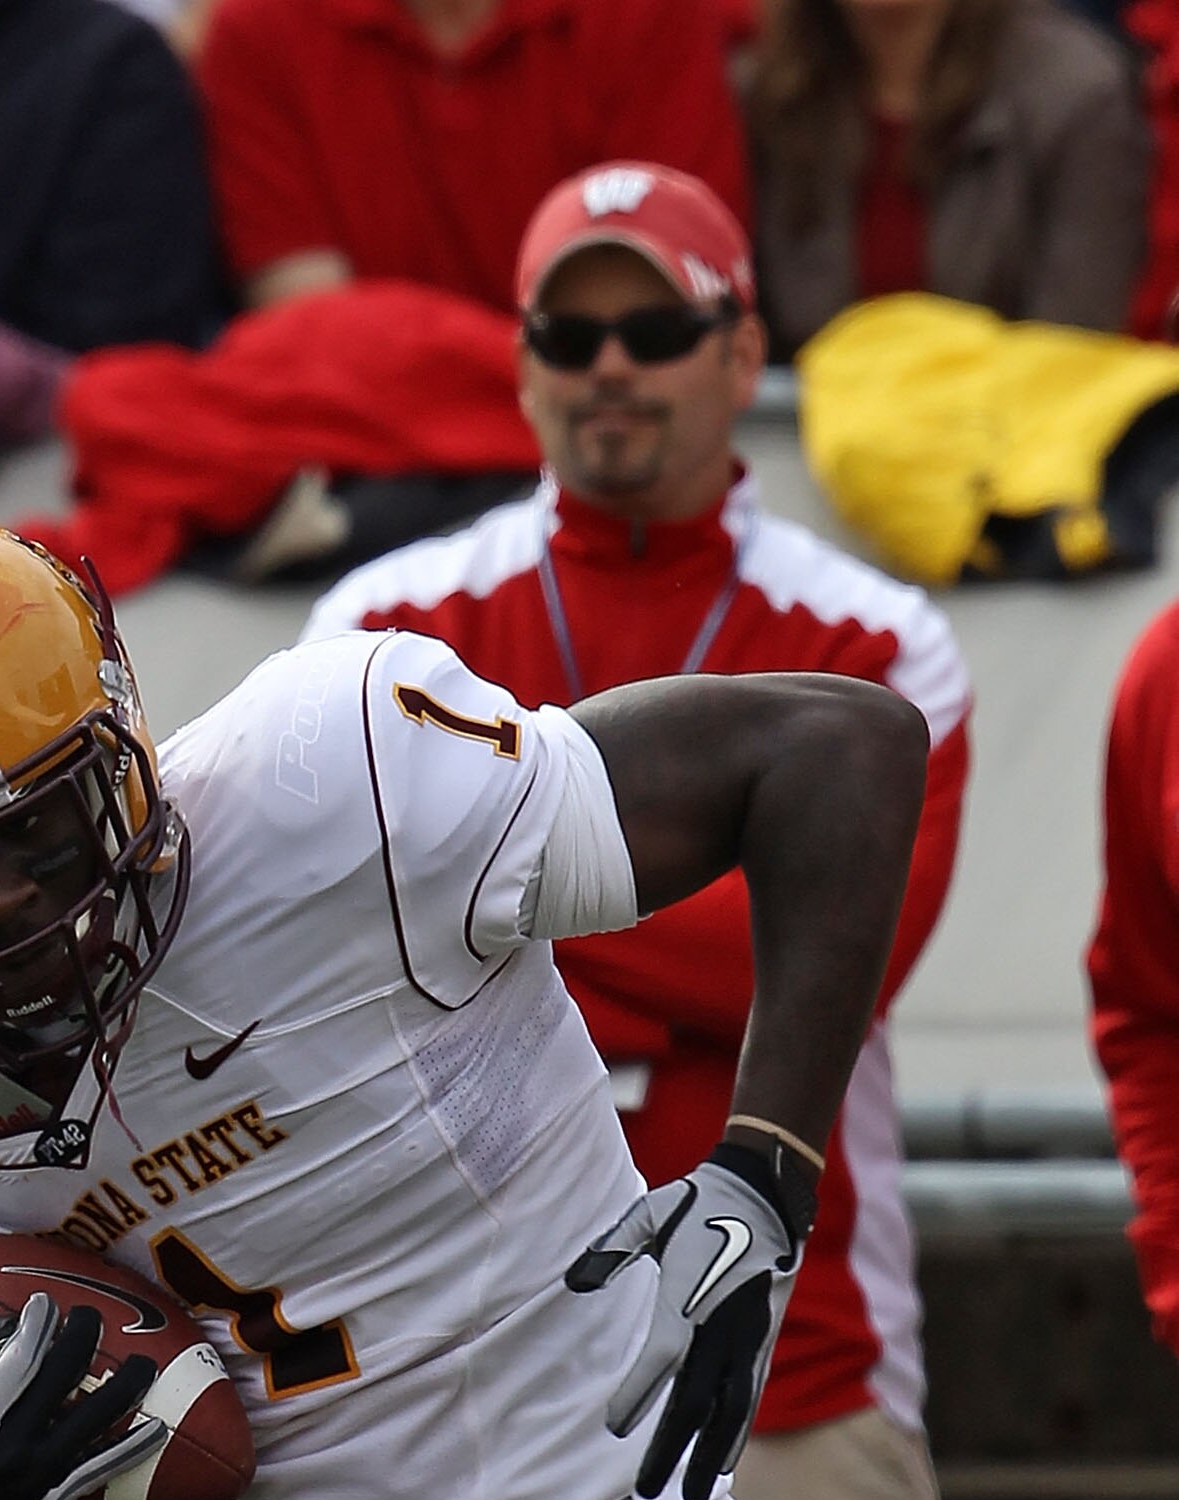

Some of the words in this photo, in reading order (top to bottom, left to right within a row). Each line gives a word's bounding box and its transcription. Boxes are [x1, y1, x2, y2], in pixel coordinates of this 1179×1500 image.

[392, 682, 521, 762] 1
[130, 1098, 292, 1209] STATE
[147, 1224, 363, 1402] 1
